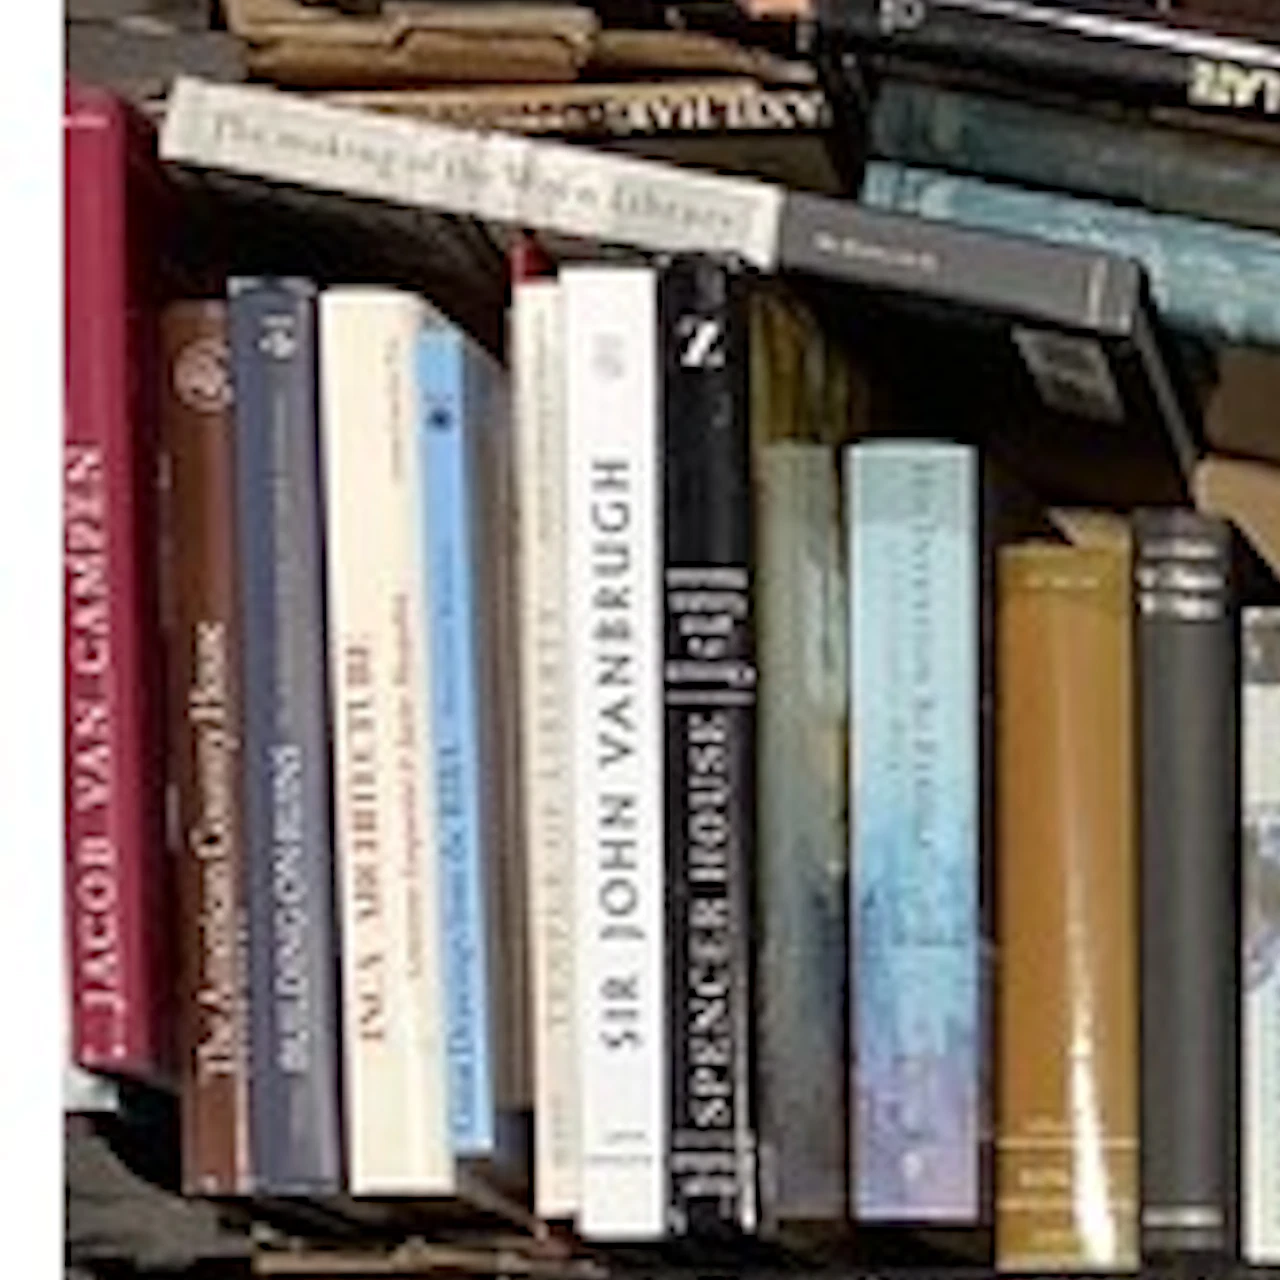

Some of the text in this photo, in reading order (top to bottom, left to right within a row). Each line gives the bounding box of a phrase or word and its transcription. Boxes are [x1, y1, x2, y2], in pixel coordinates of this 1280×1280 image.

[611, 180, 741, 233] Library
[65, 440, 126, 1014] JACOB VAN CAMPEN
[187, 621, 240, 1077] The American Country House
[346, 634, 388, 1043] INCA ARCHITECTURE
[592, 454, 645, 1053] SIR JOHN VANBRUGH
[685, 716, 730, 1127] SPENCER HOUSE
[274, 912, 309, 1069] BUILDING
